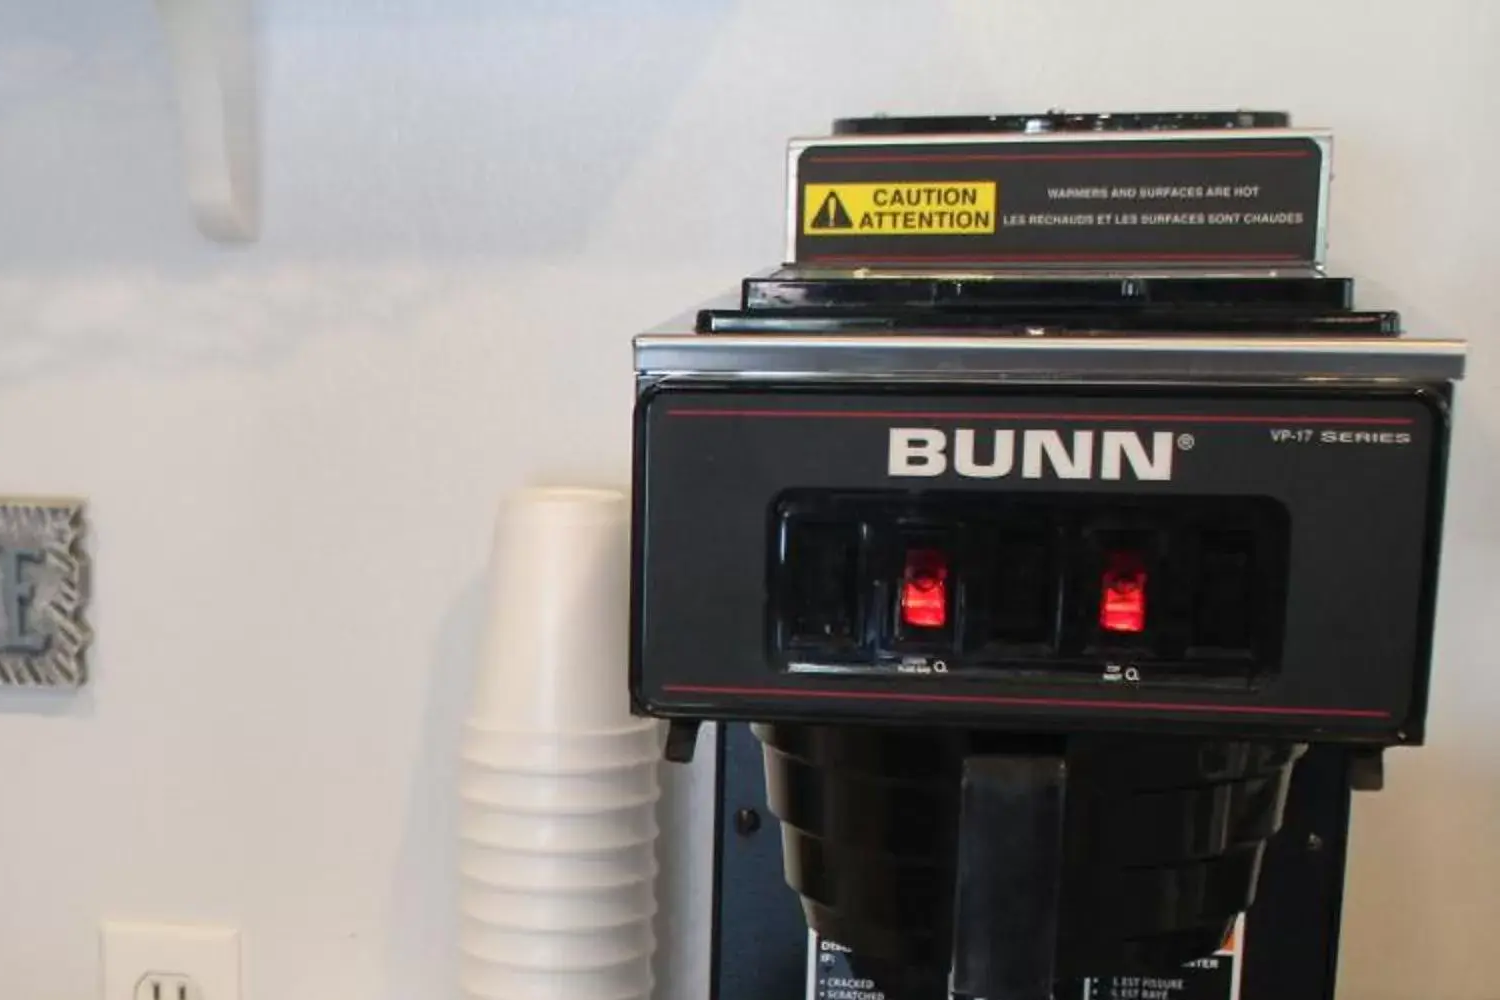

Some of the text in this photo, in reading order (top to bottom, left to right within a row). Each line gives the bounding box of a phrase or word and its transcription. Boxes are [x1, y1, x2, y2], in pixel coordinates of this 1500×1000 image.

[872, 188, 977, 206] CAUTION
[1047, 186, 1260, 199] WARMERS AND SURFACES ARE HOT
[859, 211, 990, 229] ATTENTION
[1003, 214, 1026, 226] LES
[1097, 214, 1112, 225] ET
[1115, 213, 1138, 225] LES
[1140, 213, 1205, 225] SURFACES
[1208, 213, 1241, 224] SONT
[1244, 213, 1304, 224] CHAUDES
[1271, 428, 1413, 445] VP-17 SERIES
[827, 978, 876, 989] CRACKED
